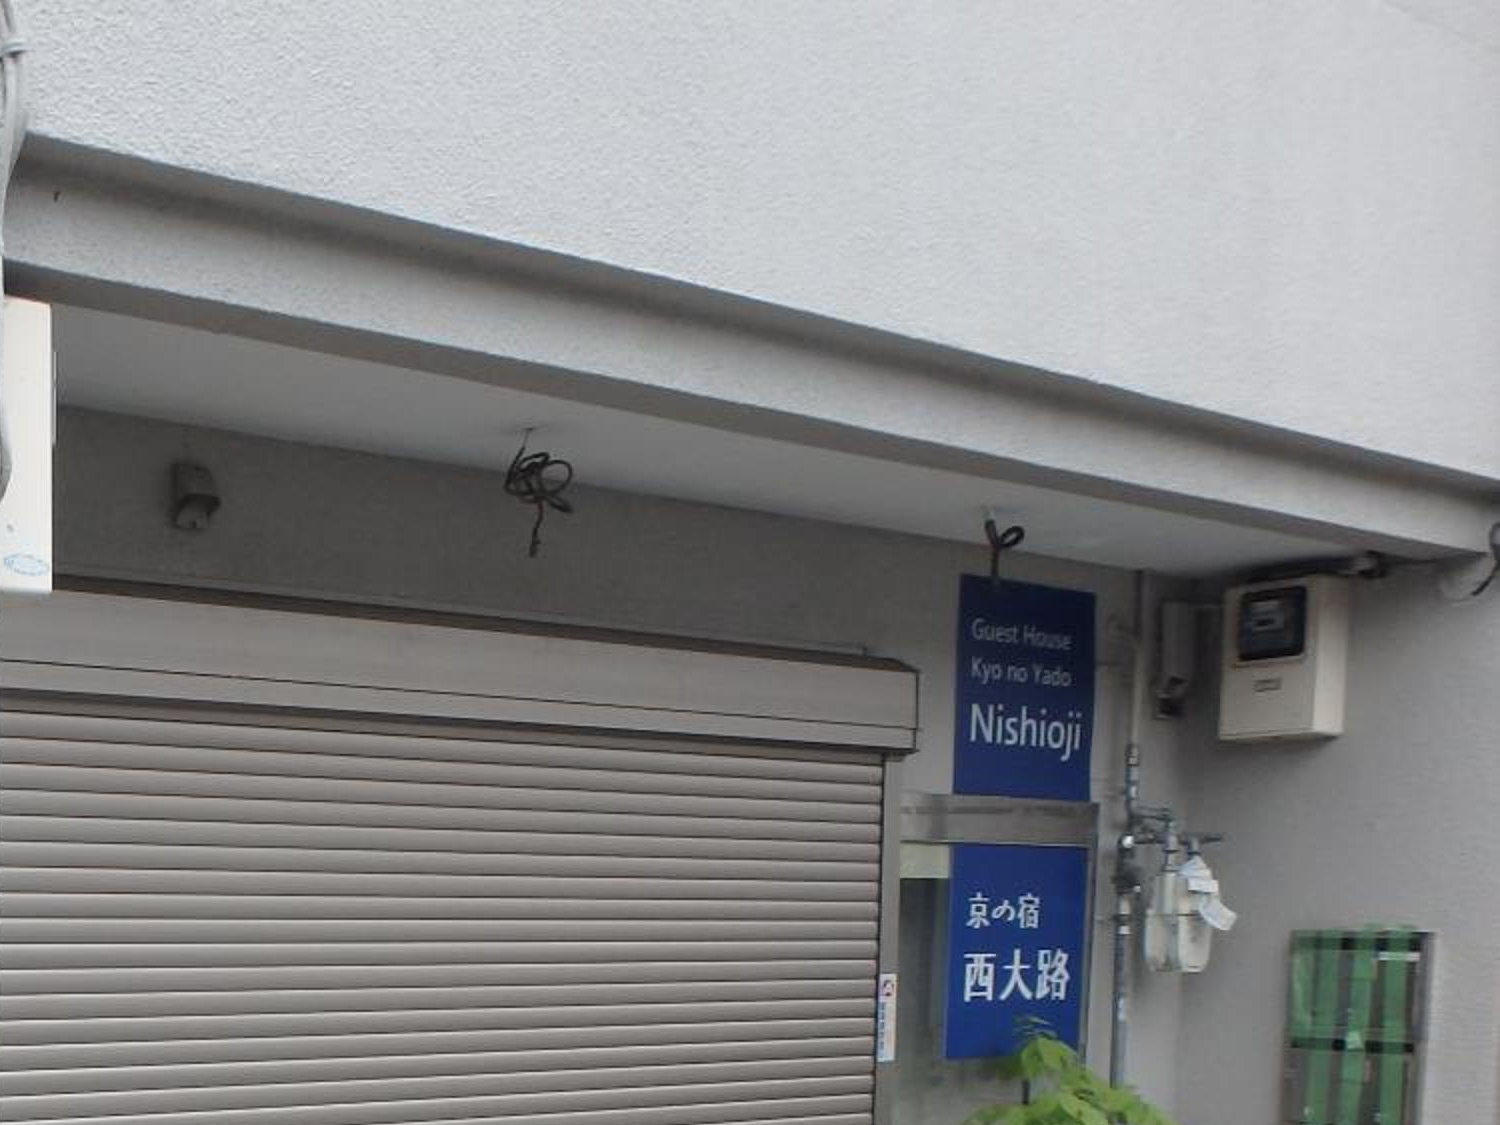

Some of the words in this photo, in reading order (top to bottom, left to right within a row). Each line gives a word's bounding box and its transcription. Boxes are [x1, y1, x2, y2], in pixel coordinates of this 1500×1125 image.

[971, 617, 1019, 645] Guest
[1023, 624, 1072, 651] House
[971, 655, 1002, 685] Kyo
[1007, 665, 1028, 683] no
[1032, 663, 1073, 687] Yado
[970, 703, 1083, 762] Nishioji
[966, 891, 1041, 930] 京の宿
[963, 948, 1071, 1003] 西大路
